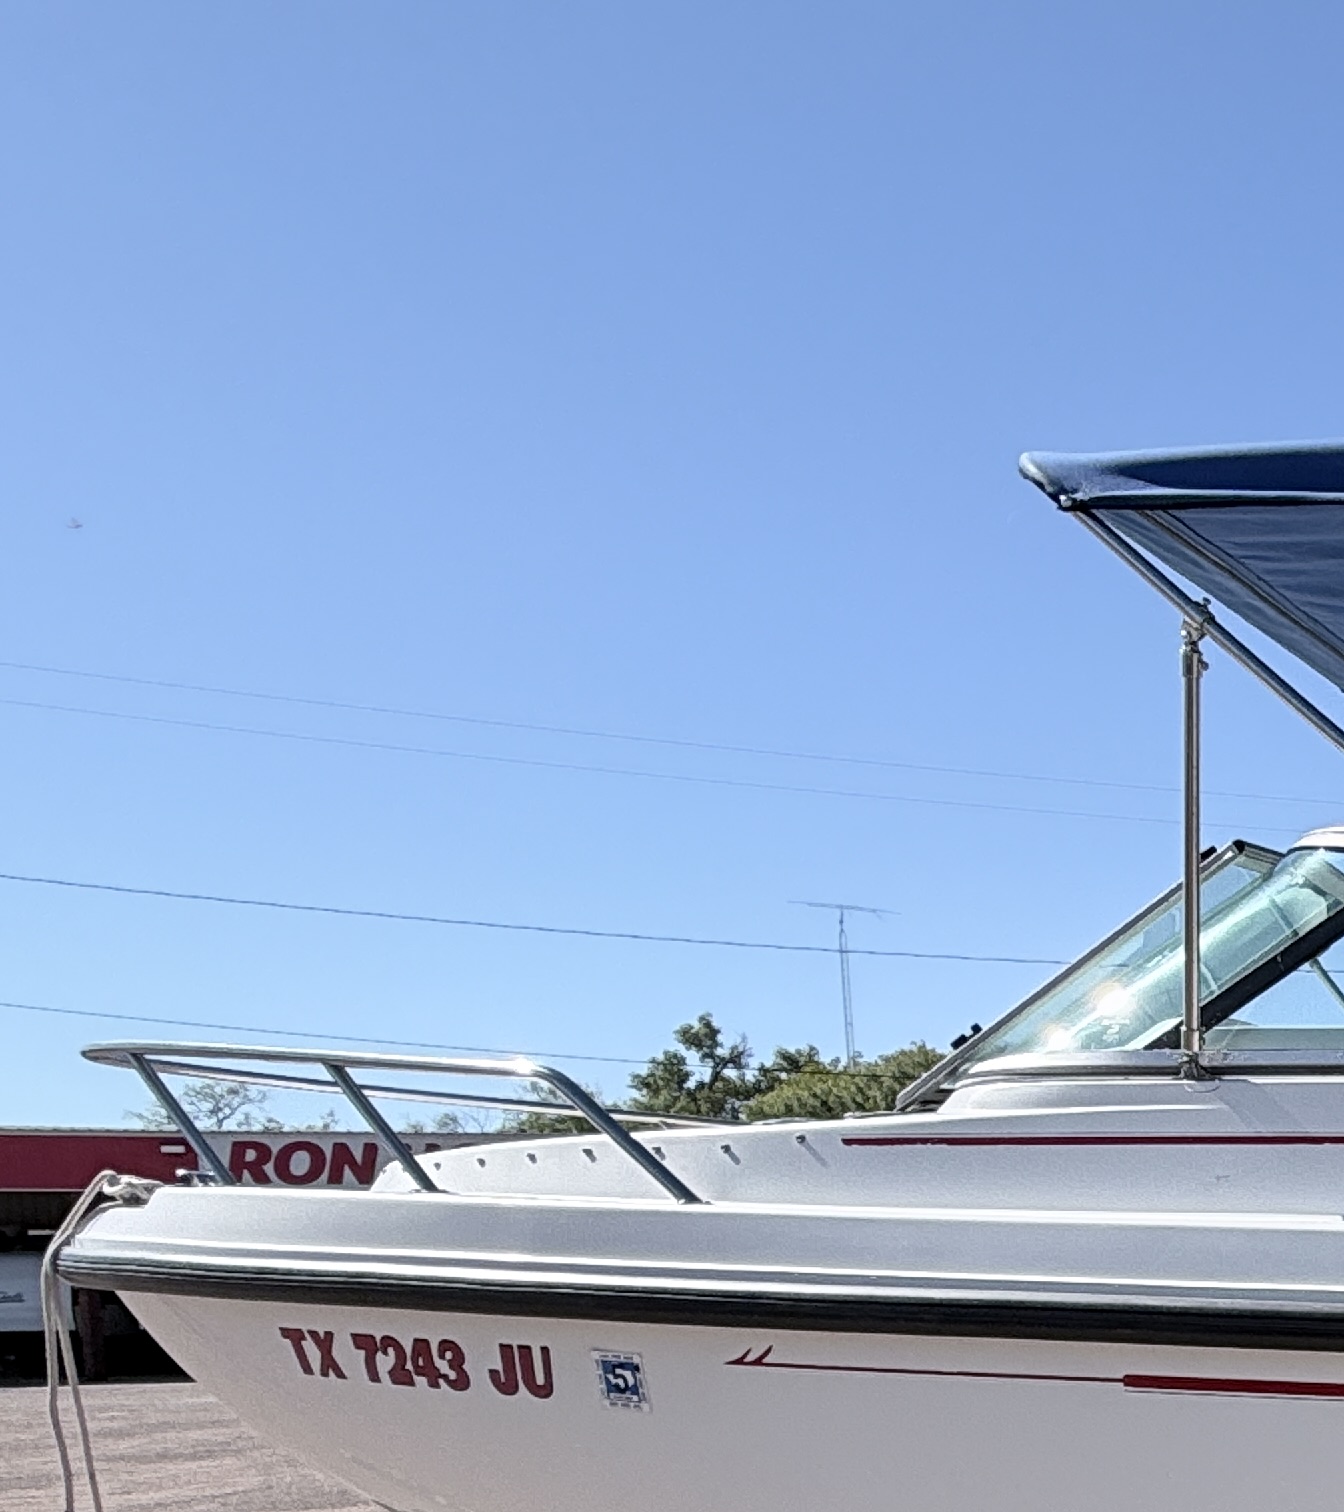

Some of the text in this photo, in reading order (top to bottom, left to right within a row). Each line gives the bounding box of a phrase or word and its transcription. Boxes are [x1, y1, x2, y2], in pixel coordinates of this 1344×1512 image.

[229, 1140, 379, 1185] RON
[279, 1327, 554, 1399] TX 7243 JU
